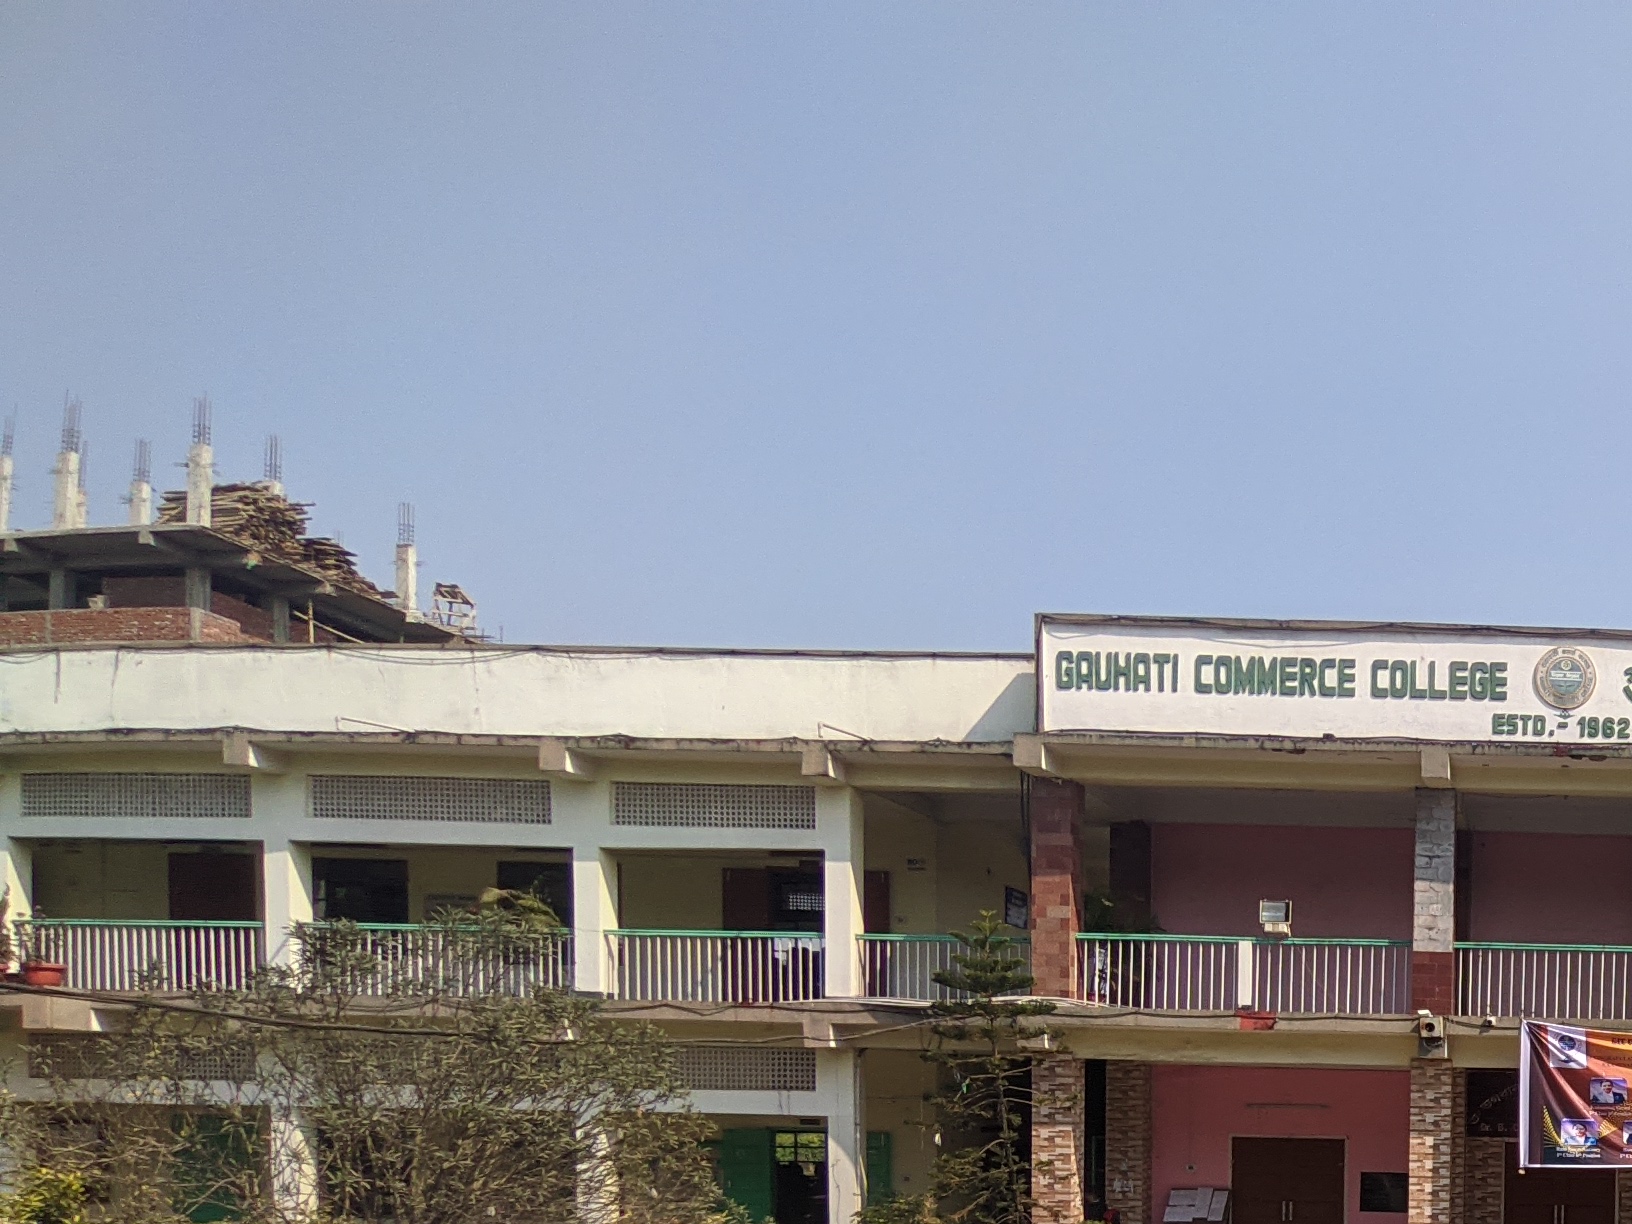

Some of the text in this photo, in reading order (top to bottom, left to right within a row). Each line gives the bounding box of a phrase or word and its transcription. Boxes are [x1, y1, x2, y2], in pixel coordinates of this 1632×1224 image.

[1055, 650, 1180, 693] GAUHATI
[1194, 654, 1356, 699] COMMERCE
[1370, 658, 1508, 701] COLLEGE
[1576, 716, 1631, 739] 1962
